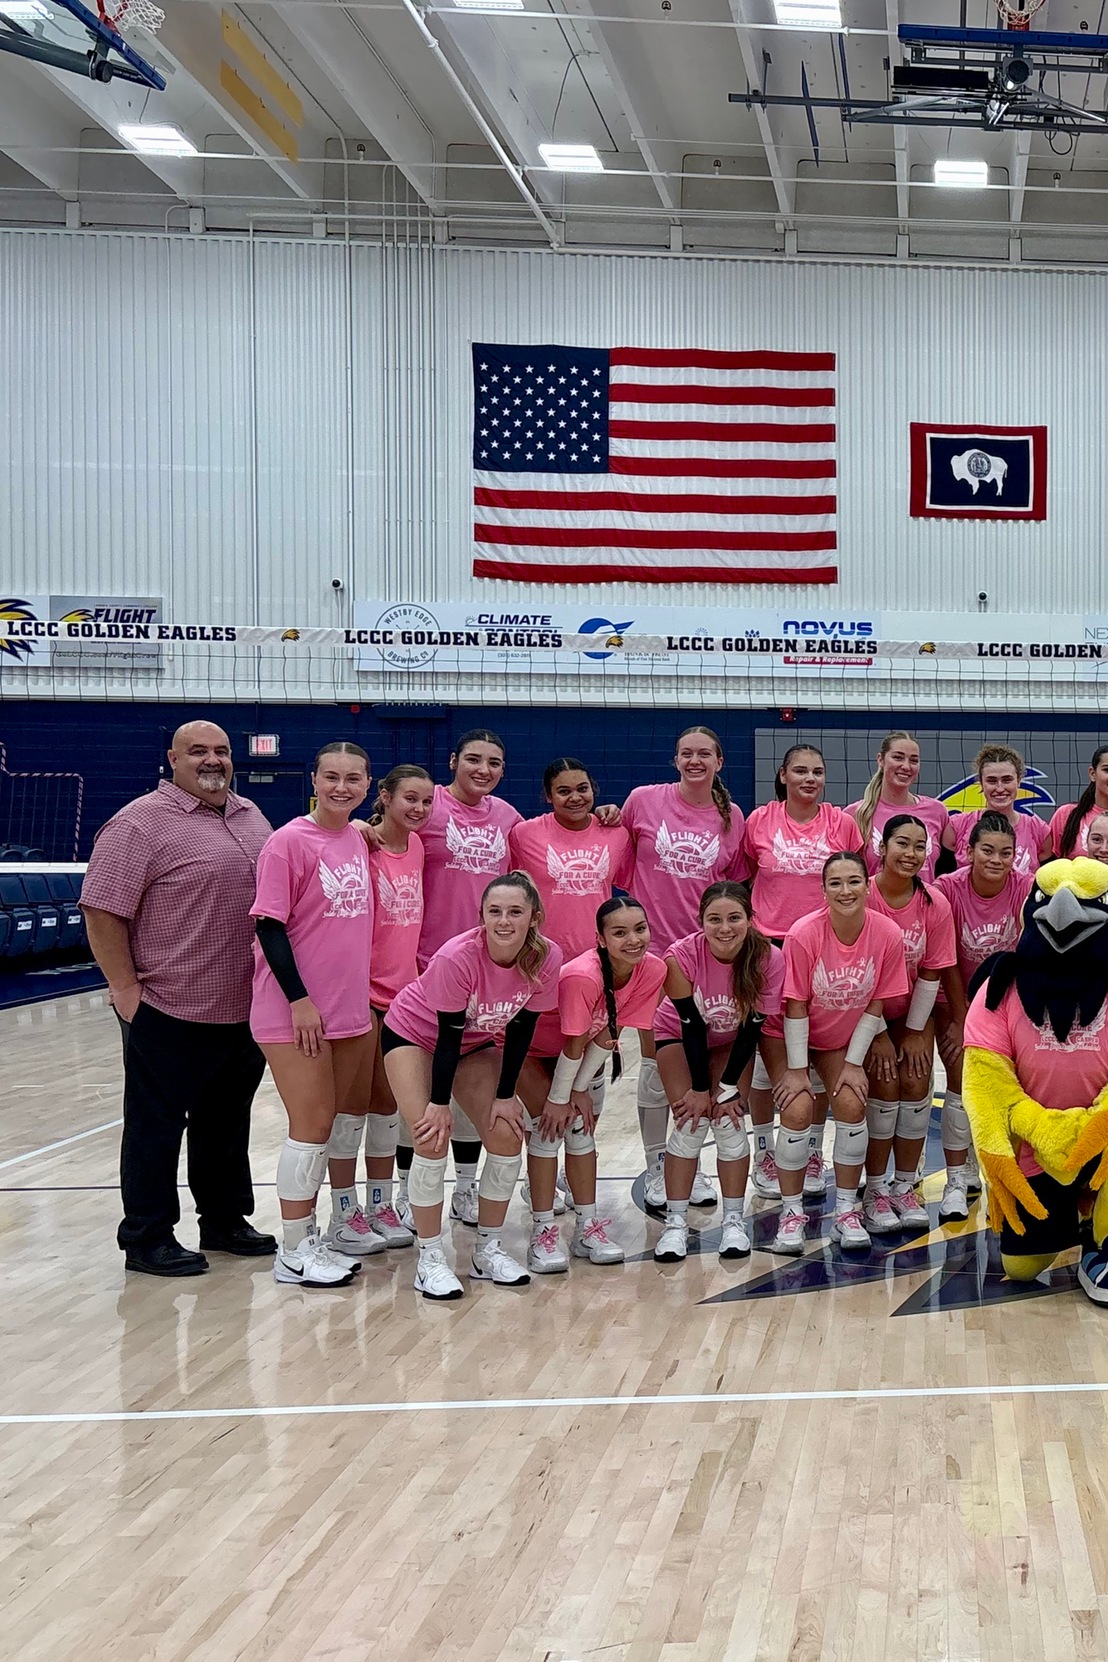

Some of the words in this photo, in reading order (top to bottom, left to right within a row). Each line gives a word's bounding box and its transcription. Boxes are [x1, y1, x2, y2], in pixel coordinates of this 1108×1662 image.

[93, 608, 156, 623] FLIGHT
[384, 608, 412, 625] WESTBY
[414, 610, 432, 626] EDGE
[477, 614, 552, 625] CLIMATE
[7, 621, 59, 637] LCCC
[67, 623, 150, 640] GOLDEN
[157, 625, 237, 642] EAGLES
[344, 629, 394, 645] LCCC
[401, 631, 479, 647] GOLDEN
[486, 633, 563, 648] EAGLES
[666, 636, 715, 651] LCCC
[722, 637, 798, 653] GOLDEN
[805, 639, 878, 654] EAGLES
[977, 643, 1023, 657] LCCC
[1029, 643, 1102, 659] GOLDEN
[387, 650, 419, 664] BREWING
[460, 826, 495, 840] FLIGHT
[670, 830, 709, 848] FLIGHT
[458, 846, 473, 854] FOR
[480, 849, 498, 858] CURE
[560, 849, 600, 862] FLIGHT
[664, 850, 679, 859] FOR
[680, 852, 686, 860] A
[687, 855, 706, 866] CURE
[333, 862, 362, 879] FLIGHT
[559, 871, 574, 879] FOR
[582, 871, 601, 879] CURE
[828, 967, 865, 982] FLIGHT
